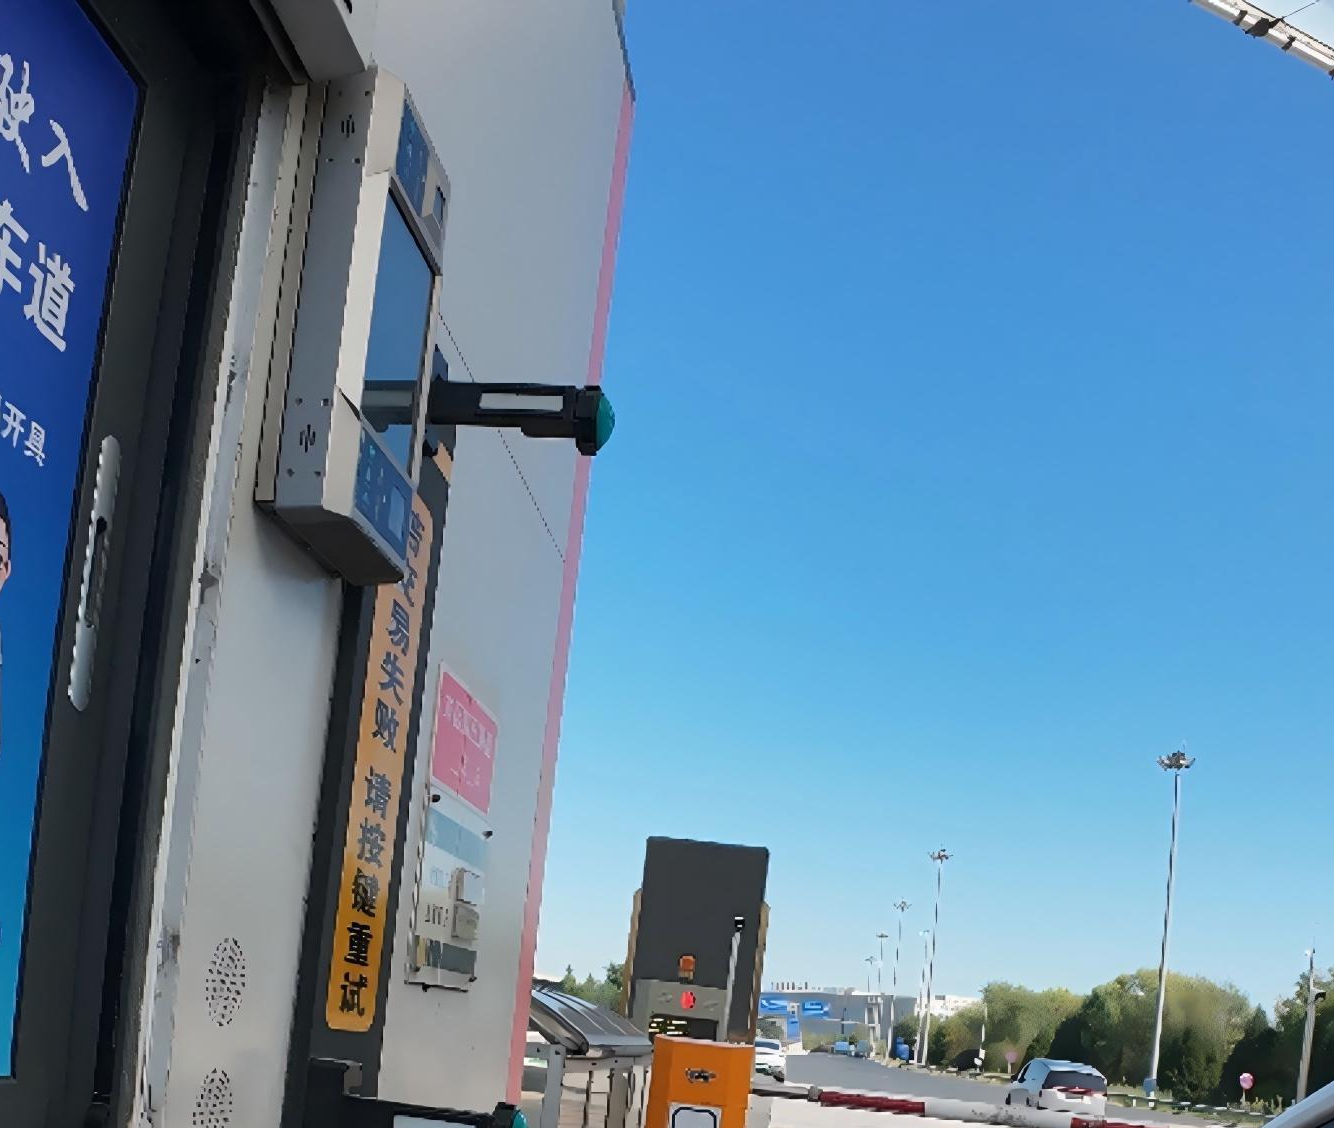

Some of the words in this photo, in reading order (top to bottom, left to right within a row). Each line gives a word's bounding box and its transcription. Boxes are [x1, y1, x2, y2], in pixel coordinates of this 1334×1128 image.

[339, 765, 392, 1017] 请按键重试
